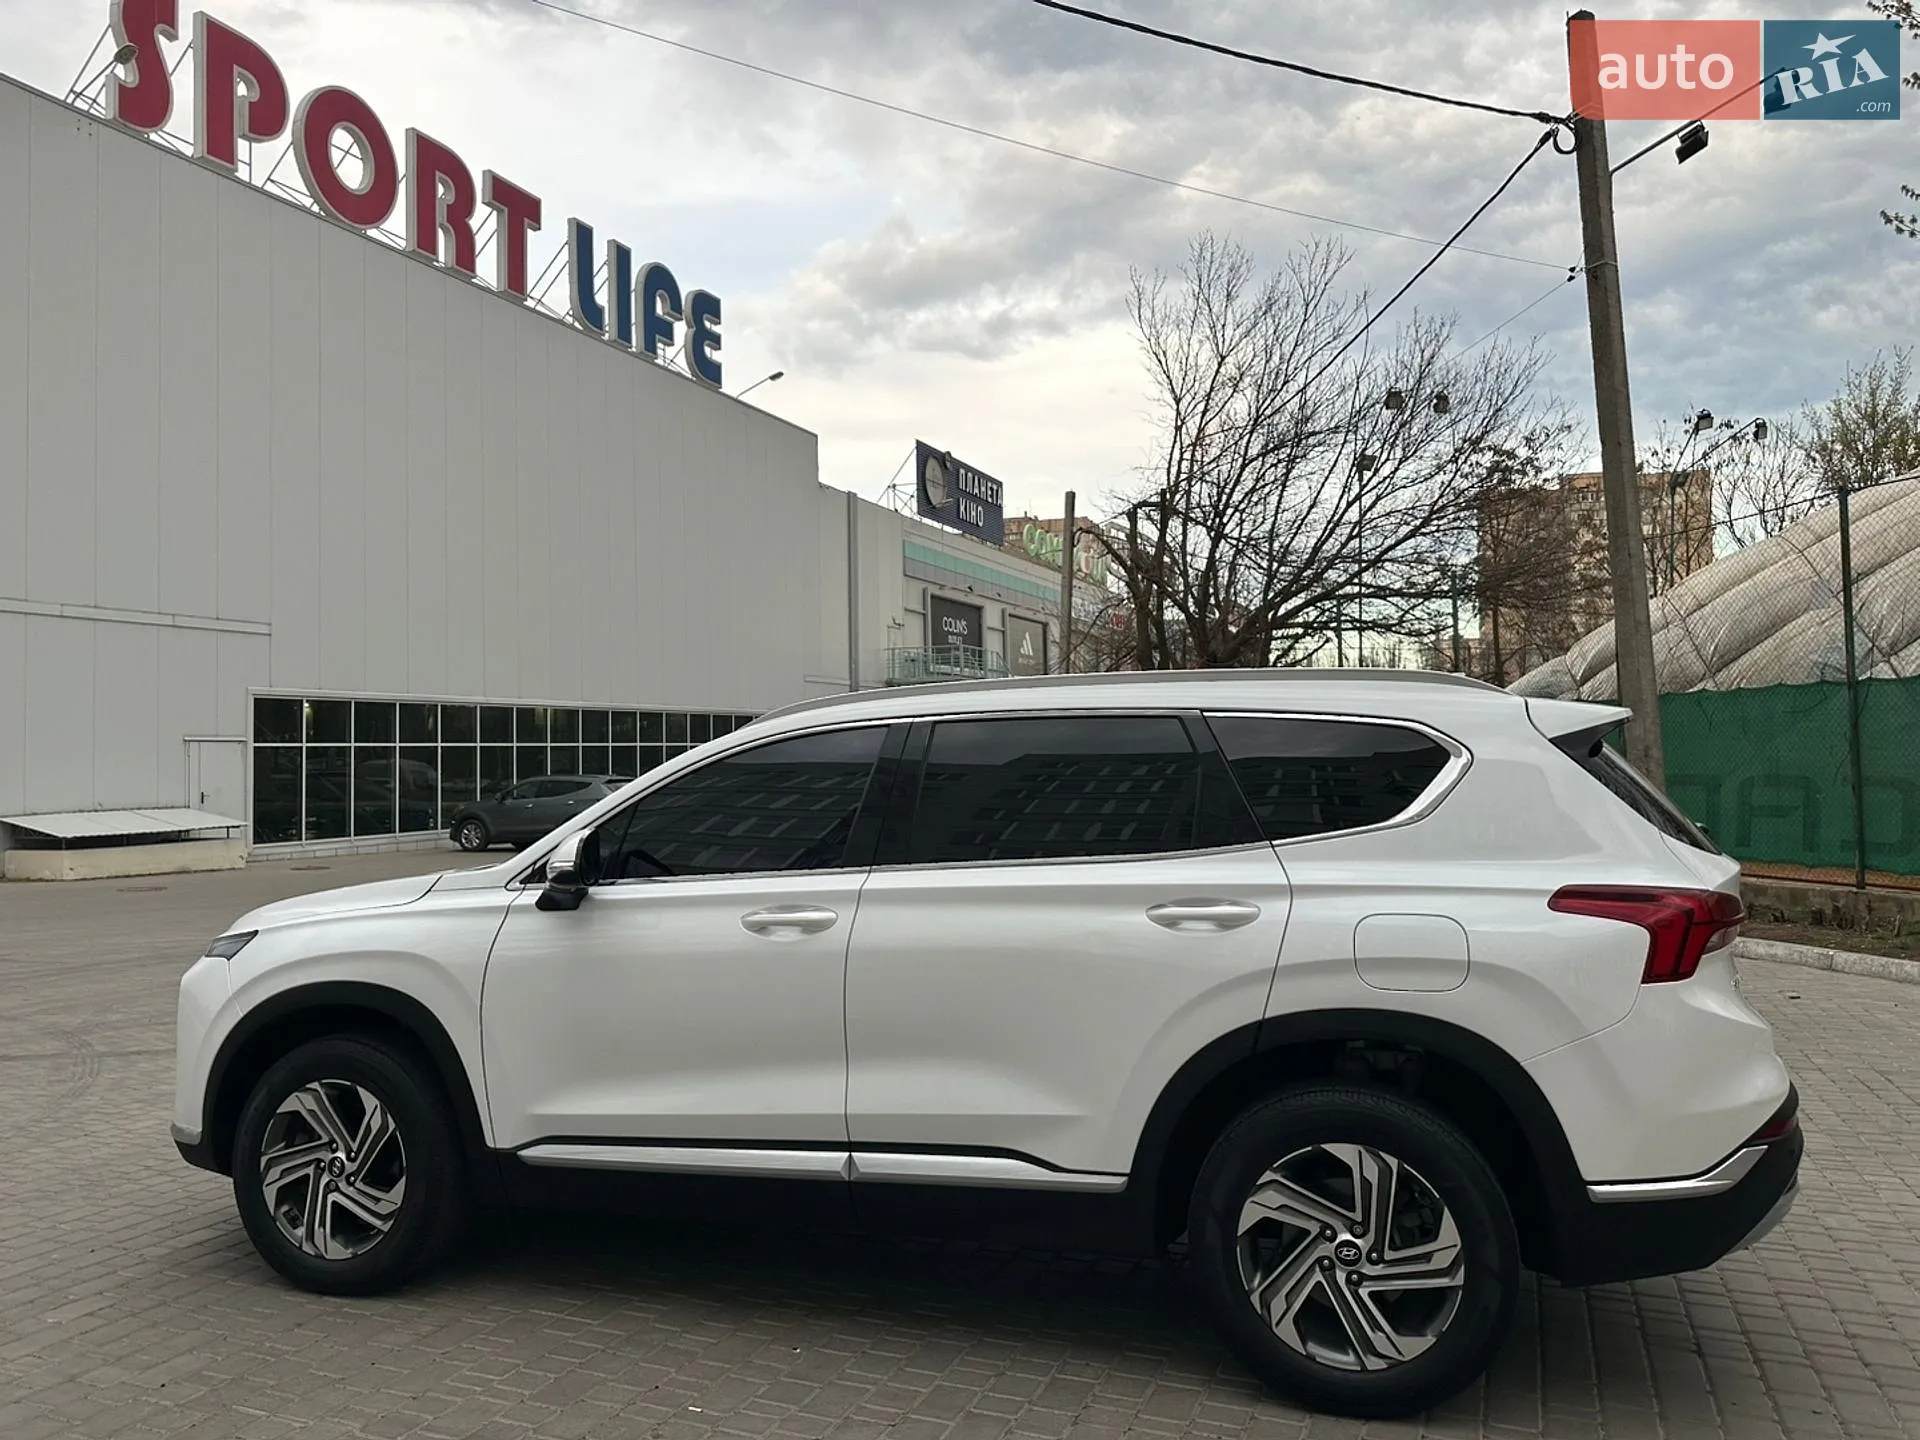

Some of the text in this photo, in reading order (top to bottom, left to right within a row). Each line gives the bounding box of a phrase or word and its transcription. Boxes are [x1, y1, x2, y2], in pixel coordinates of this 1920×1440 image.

[107, 0, 722, 388] SPORT LIFE
[959, 468, 1003, 507] ПЛАНЕТА
[959, 497, 984, 527] КІНО
